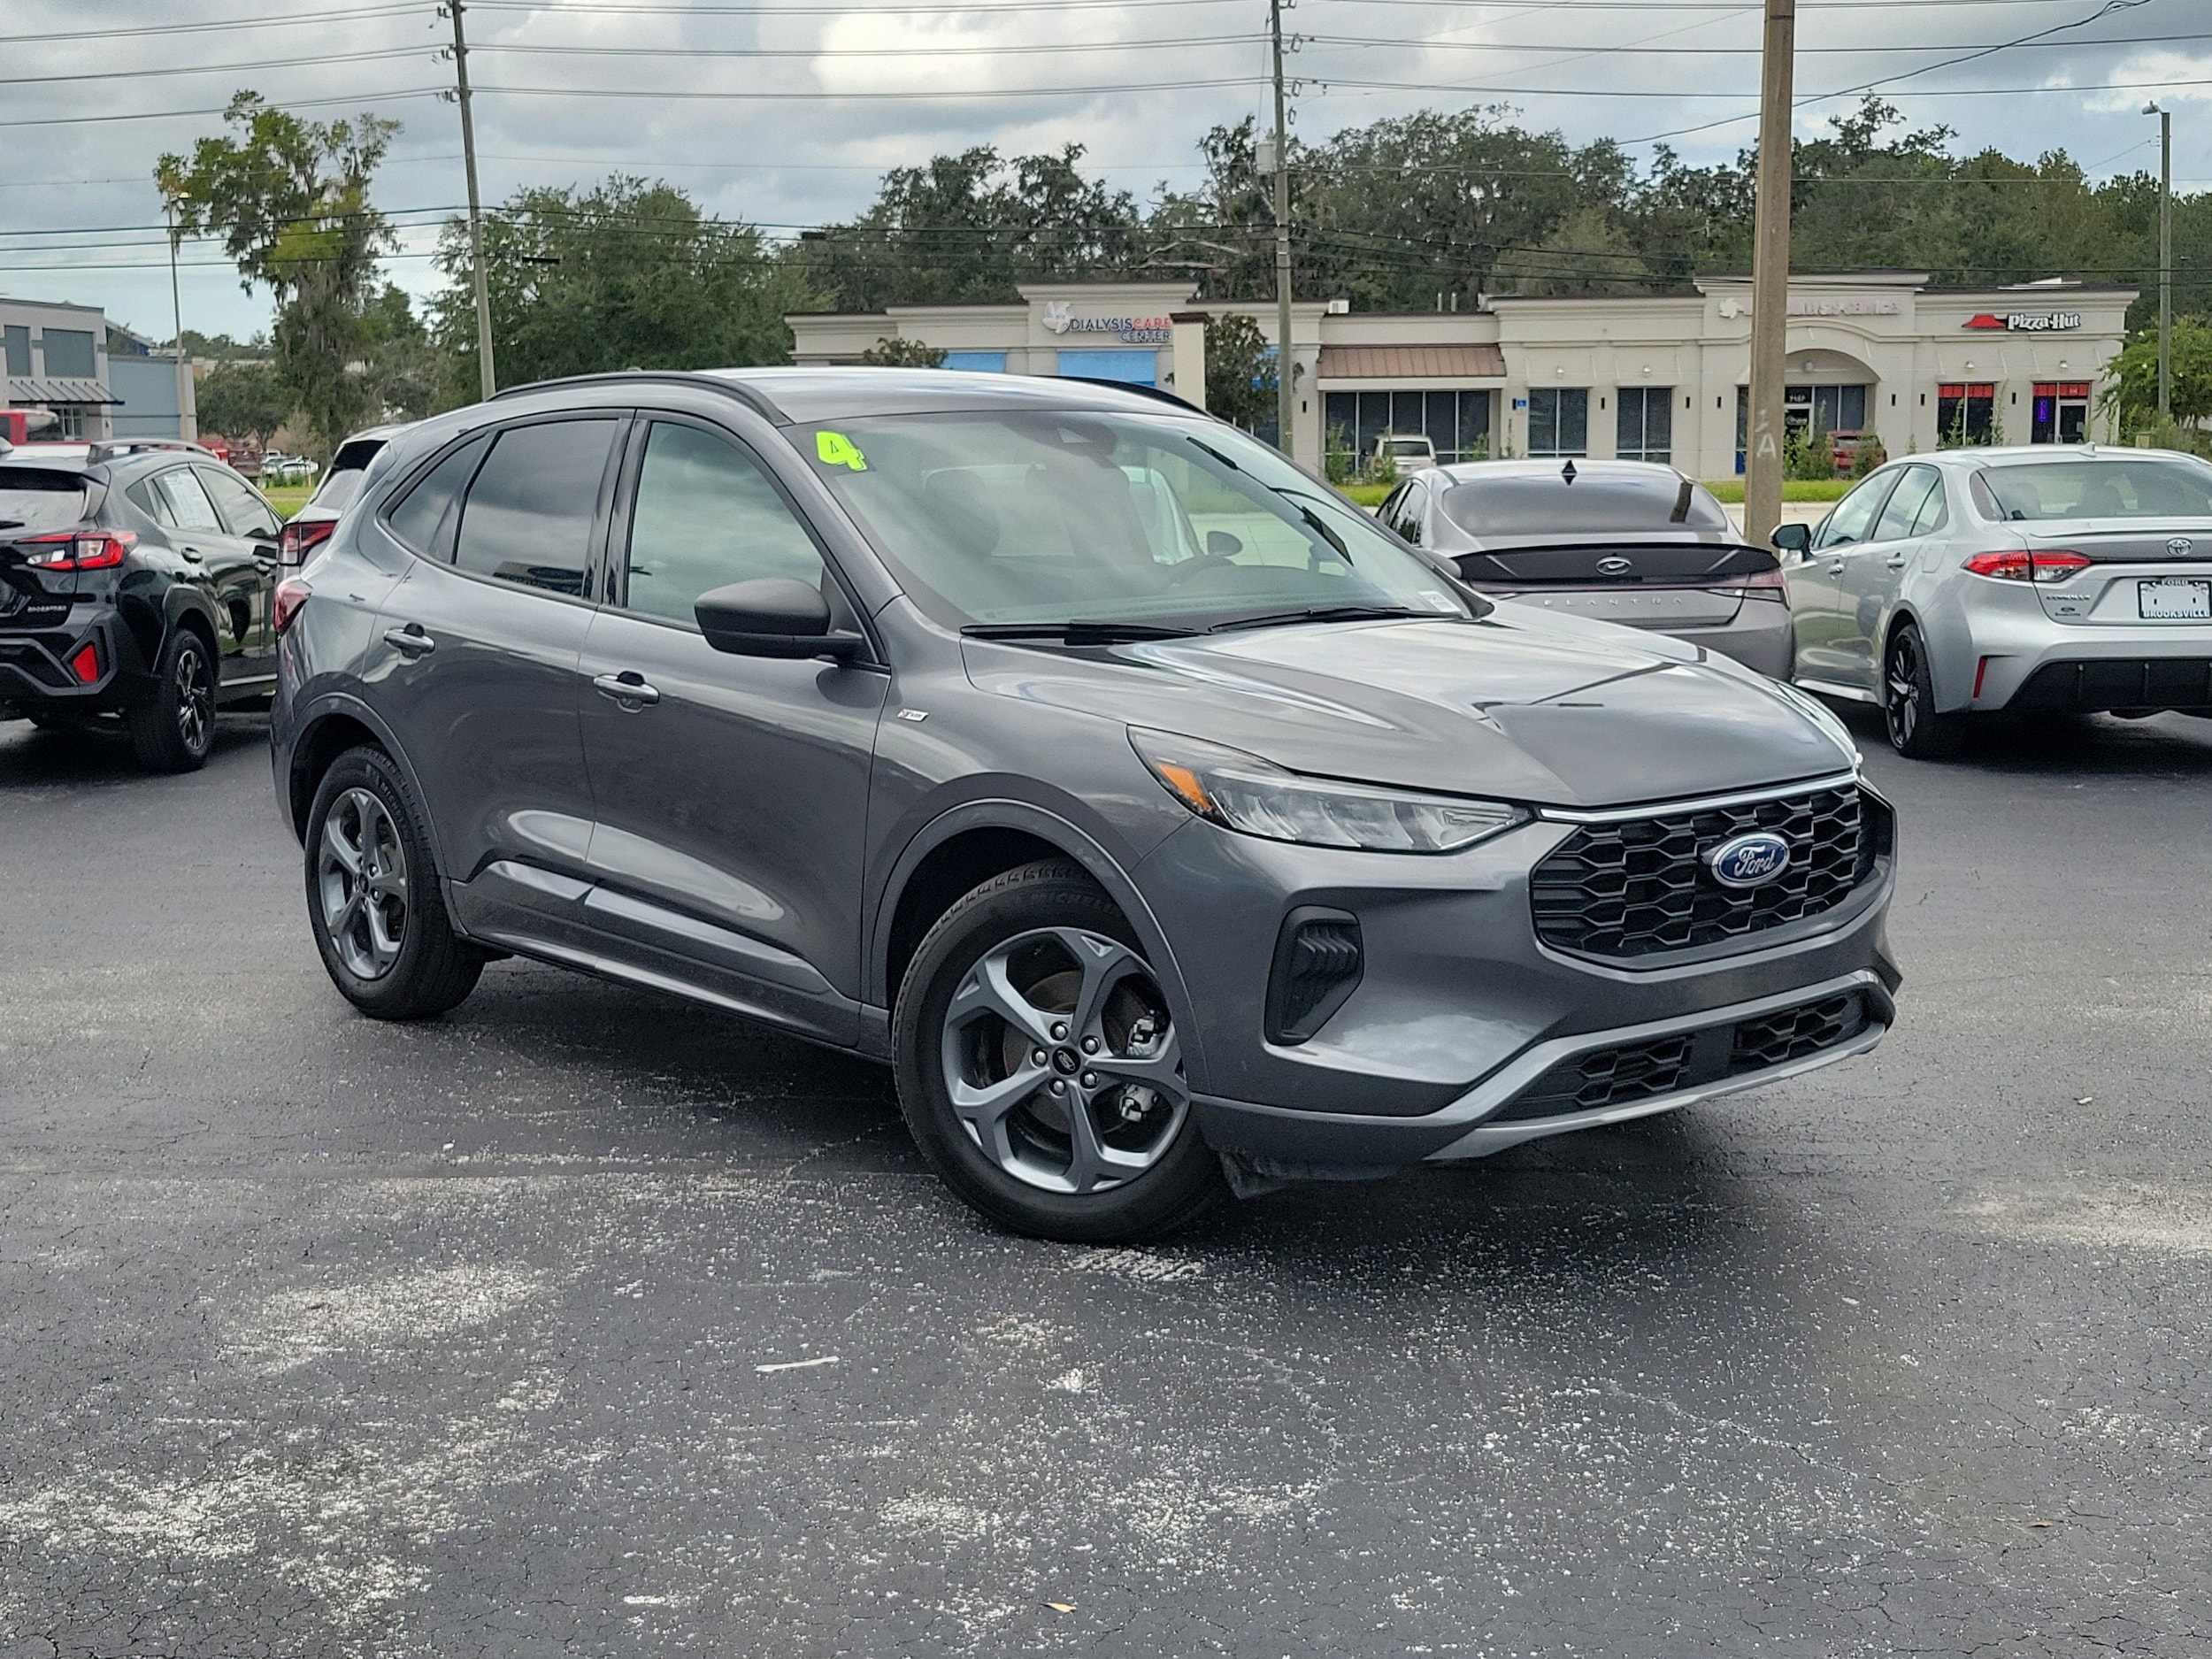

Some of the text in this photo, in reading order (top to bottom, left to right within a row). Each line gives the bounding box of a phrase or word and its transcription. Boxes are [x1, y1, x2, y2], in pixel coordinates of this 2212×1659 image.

[2008, 312, 2080, 330] Pizza Hut
[1120, 330, 1171, 342] CENTER
[816, 431, 868, 471] 4
[1756, 433, 1777, 458] A
[1543, 596, 1683, 606] ELANTRA
[2143, 609, 2209, 618] BROOKSVILLE
[1734, 845, 1777, 877] Ford
